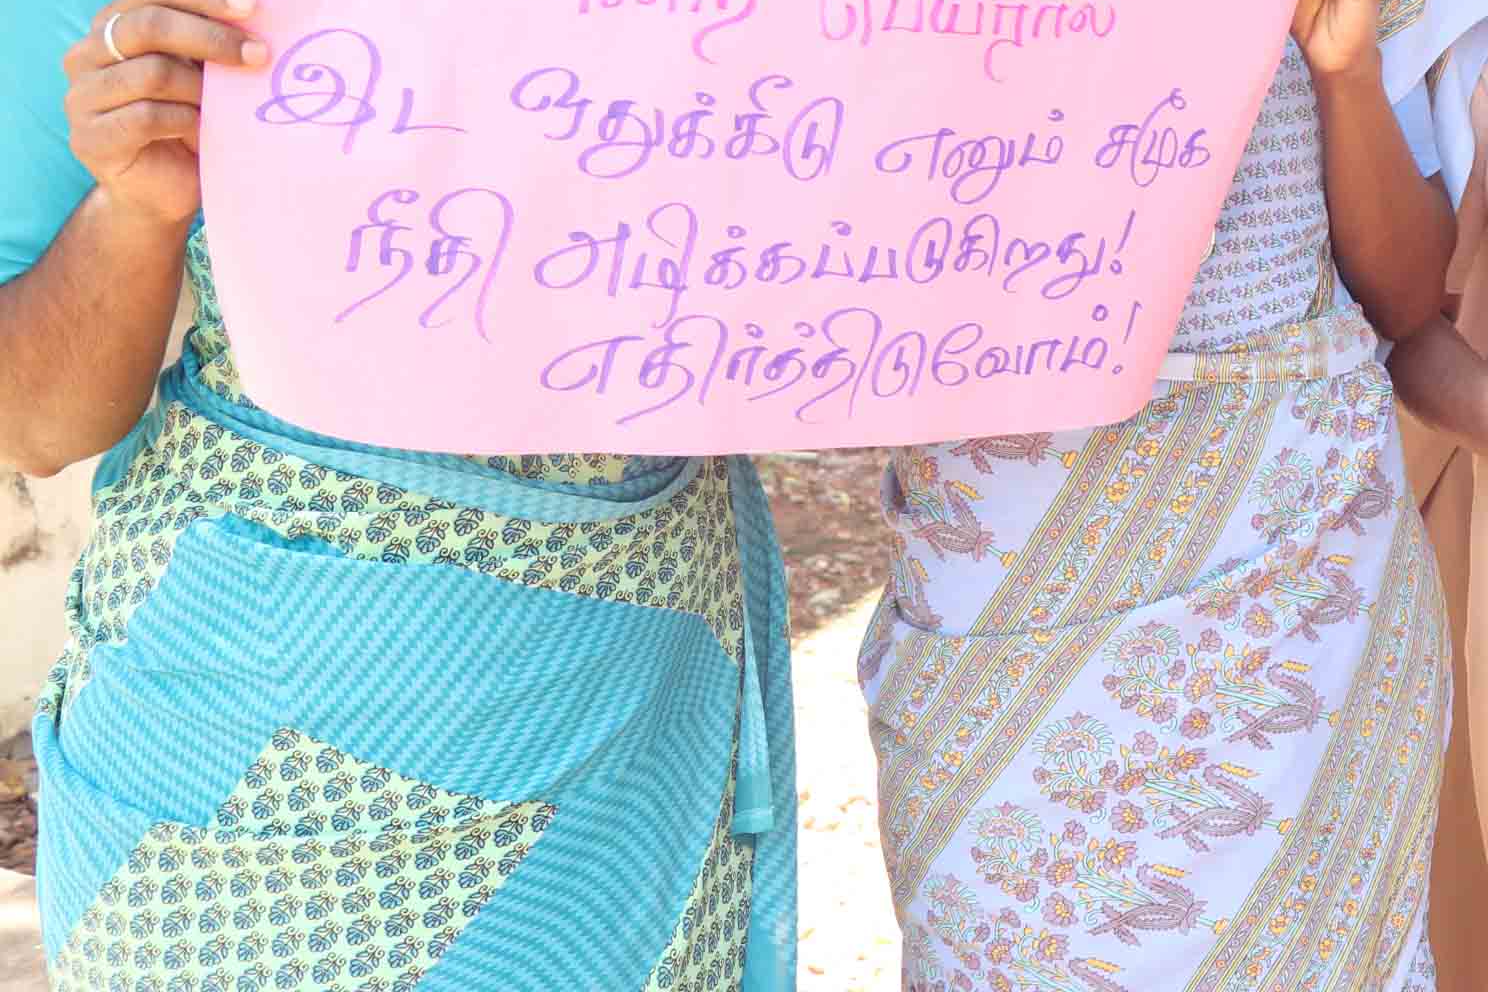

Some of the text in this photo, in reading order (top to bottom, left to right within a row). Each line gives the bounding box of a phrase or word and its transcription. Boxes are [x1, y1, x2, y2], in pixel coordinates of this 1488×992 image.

[254, 27, 469, 155] இட
[510, 66, 845, 182] ஒதுக்கீடு
[874, 108, 1066, 205] எனும்
[333, 187, 514, 344] நீதி
